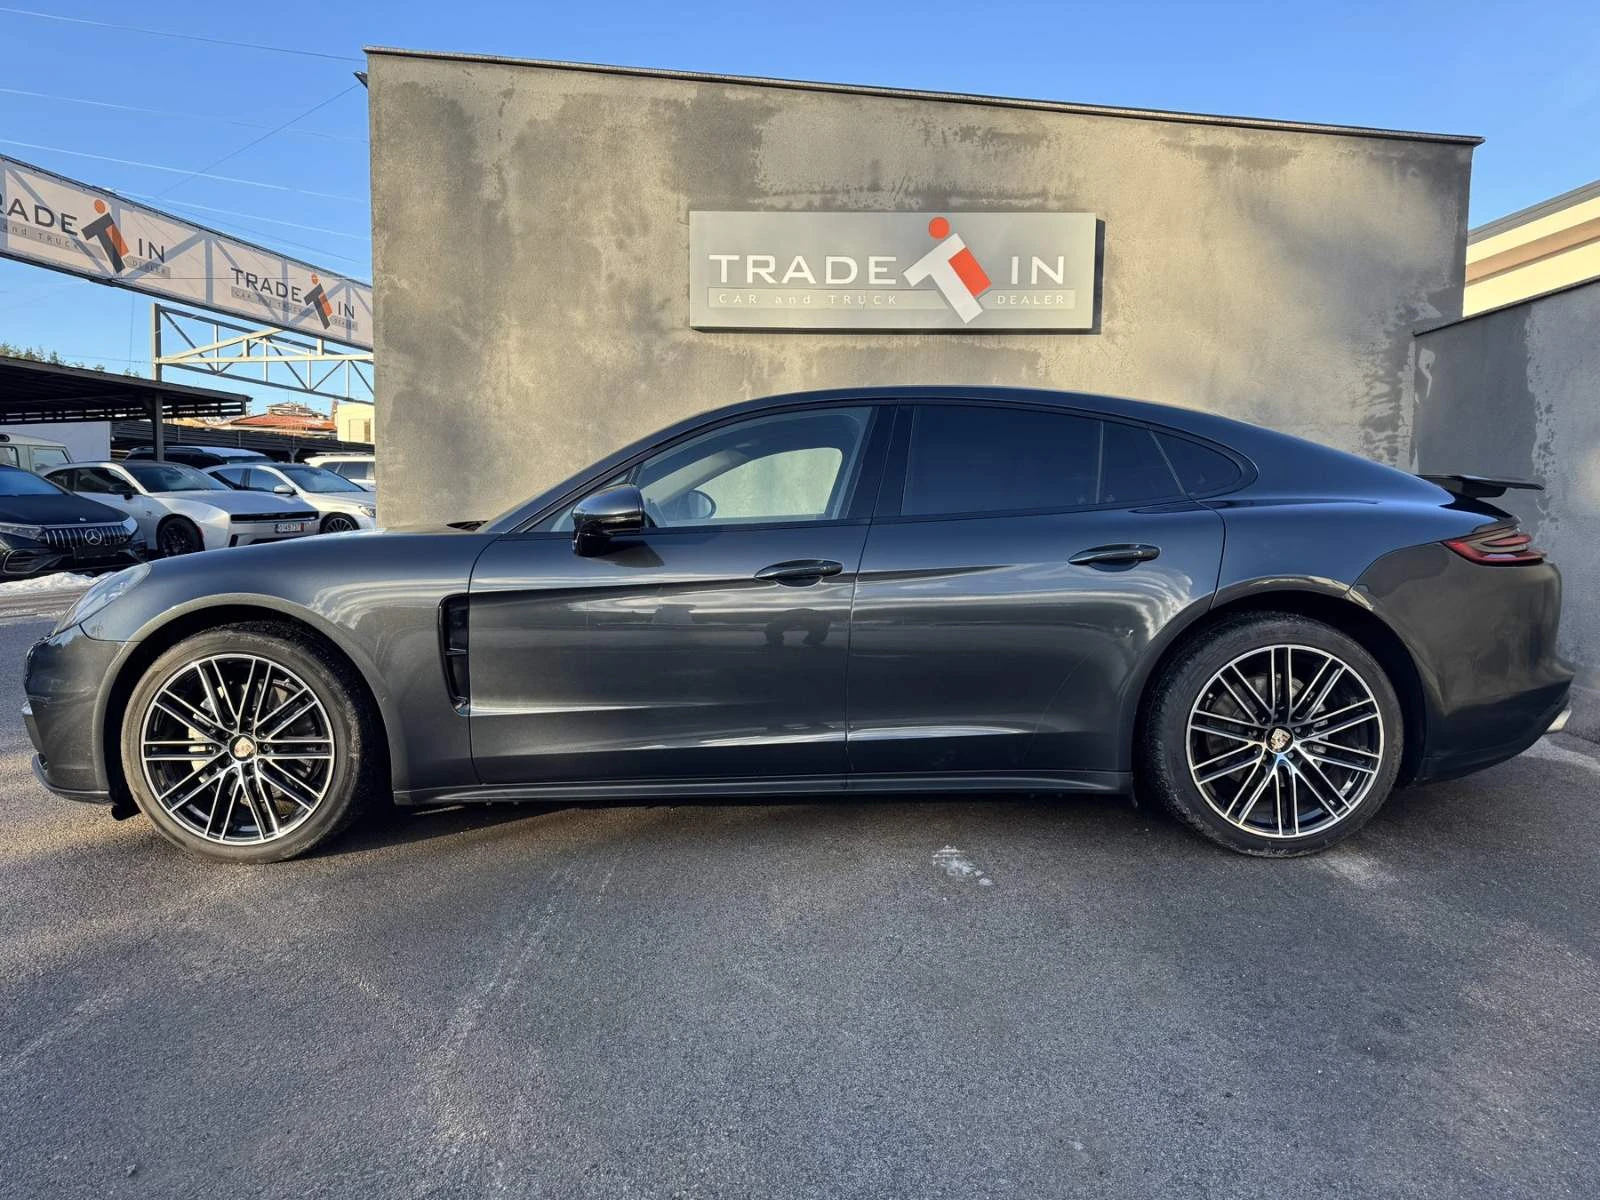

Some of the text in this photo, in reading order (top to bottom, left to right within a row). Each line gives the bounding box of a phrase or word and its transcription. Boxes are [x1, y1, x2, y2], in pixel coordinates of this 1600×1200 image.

[0, 192, 78, 236] ADE
[138, 238, 165, 264] IN
[708, 254, 897, 285] TRADE
[1011, 256, 1065, 285] IN
[230, 267, 302, 303] TRADE
[338, 301, 355, 320] IN
[719, 294, 897, 305] CAR and TRUCK
[997, 295, 1065, 305] DEALER
